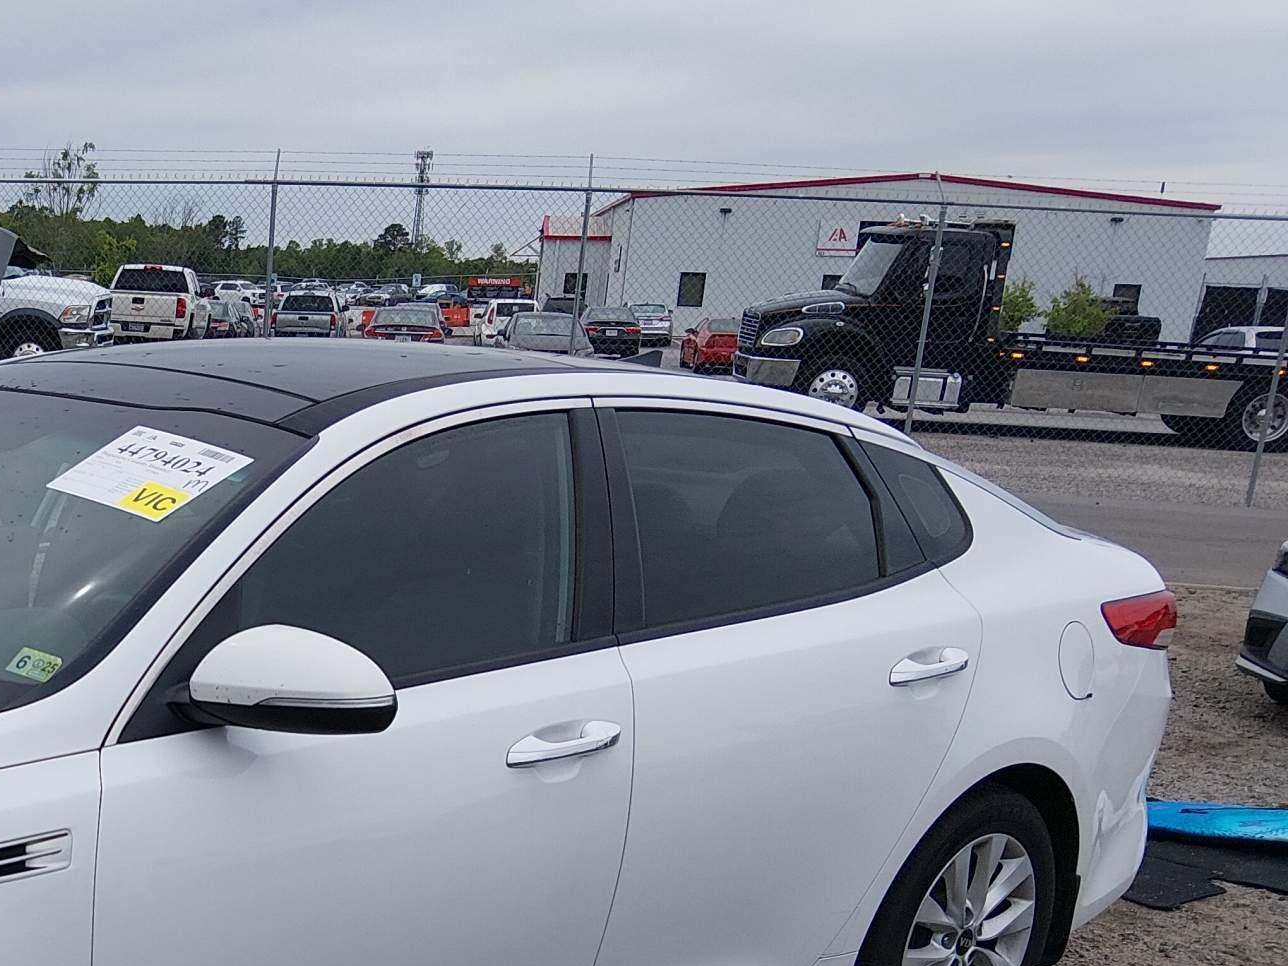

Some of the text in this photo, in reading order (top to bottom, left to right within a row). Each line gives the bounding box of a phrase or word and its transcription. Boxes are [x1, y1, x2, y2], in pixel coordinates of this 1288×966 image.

[117, 442, 215, 477] 44794024
[132, 487, 177, 511] VIC
[16, 655, 58, 673] 6 25
